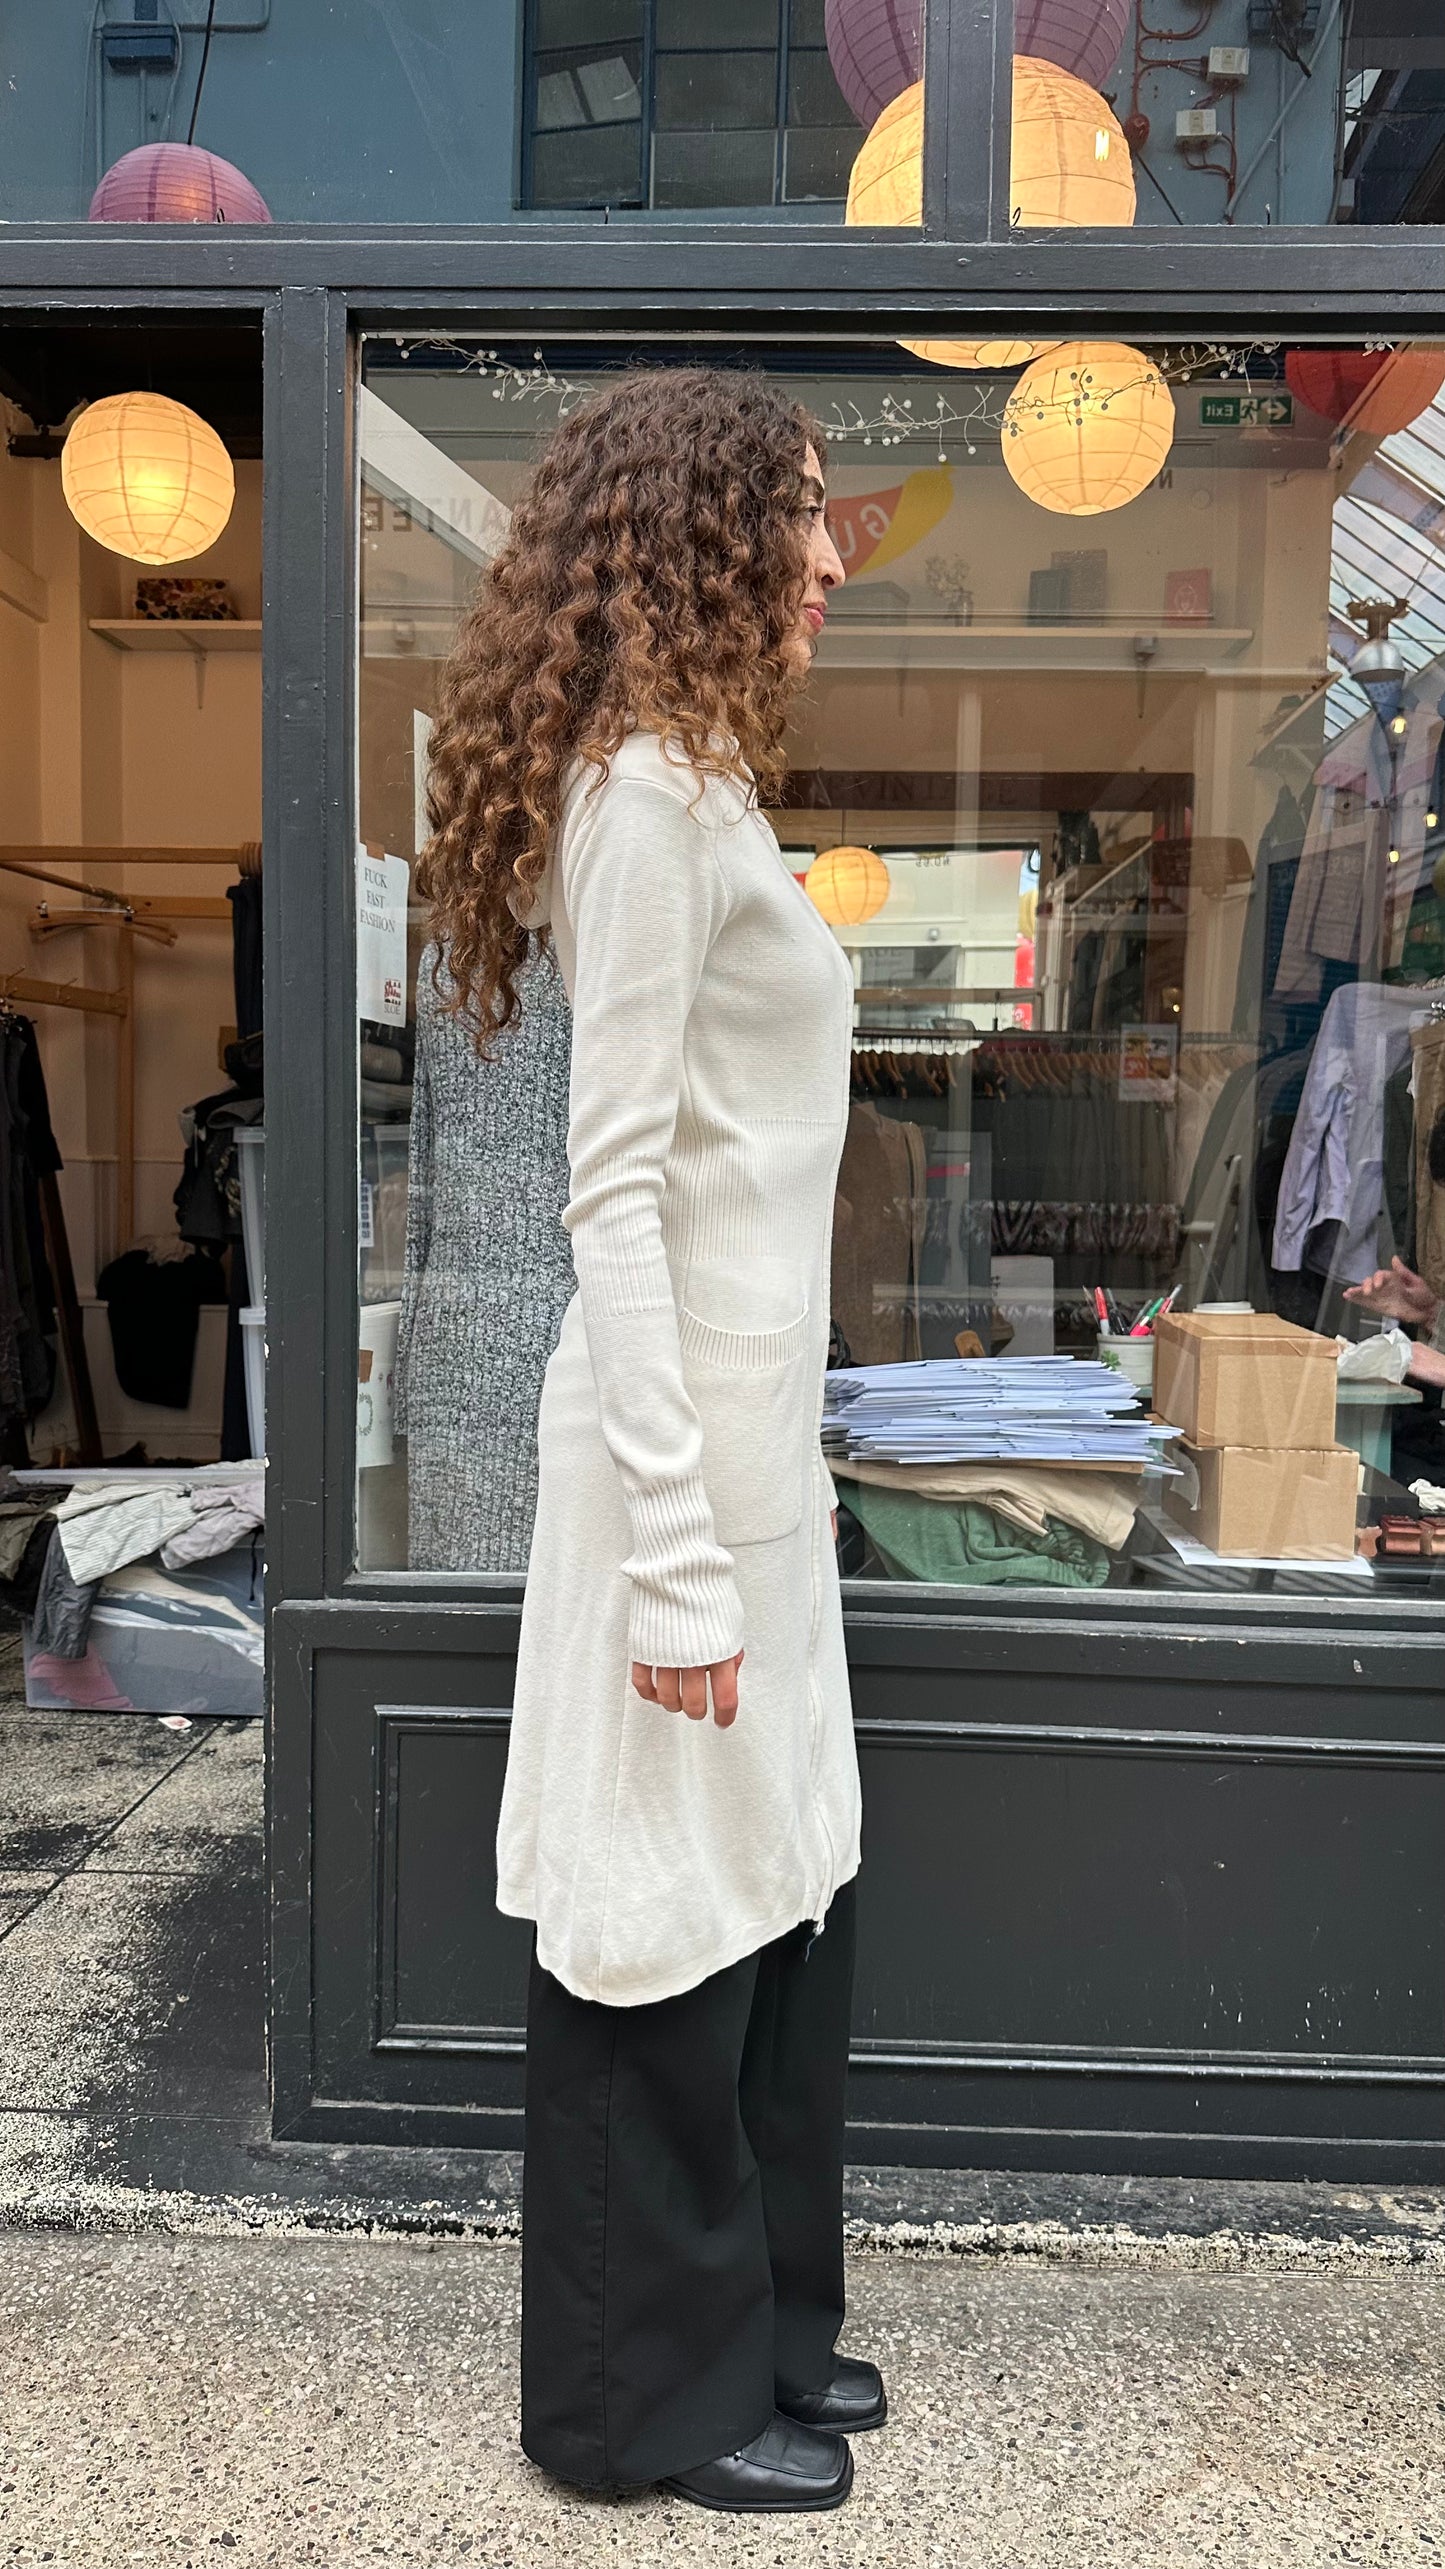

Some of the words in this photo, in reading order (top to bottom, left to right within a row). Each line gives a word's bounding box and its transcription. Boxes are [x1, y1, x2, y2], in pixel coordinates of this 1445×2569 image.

[364, 867, 388, 888] FUCK
[367, 892, 386, 909] FAST
[360, 908, 396, 933] FASHION
